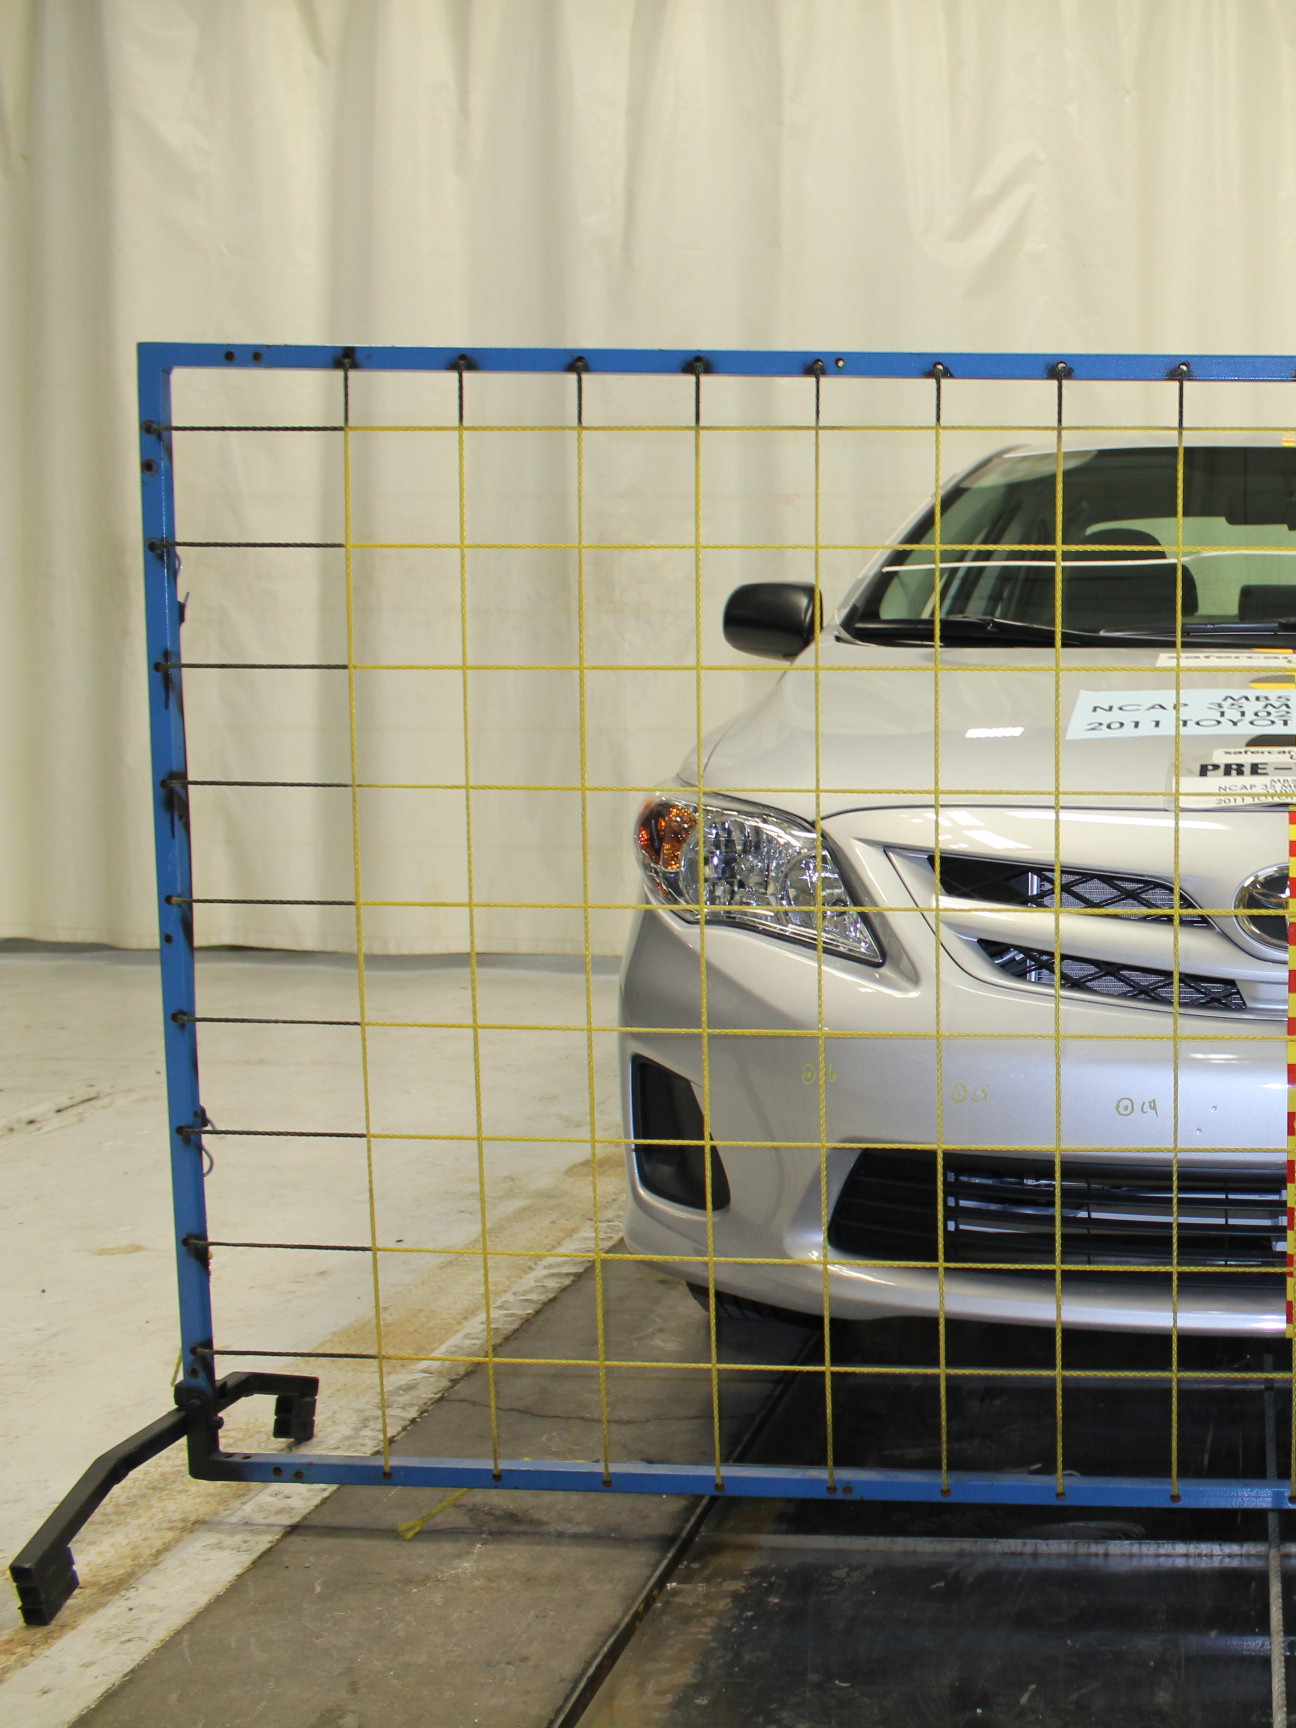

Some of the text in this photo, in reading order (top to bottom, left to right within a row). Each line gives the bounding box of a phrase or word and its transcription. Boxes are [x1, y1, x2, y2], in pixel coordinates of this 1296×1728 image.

[1090, 702, 1189, 713] NCAP
[1206, 702, 1244, 710] 35
[1085, 719, 1162, 731] 2011
[1217, 784, 1257, 793] NCAP
[1215, 797, 1245, 805] 2011
